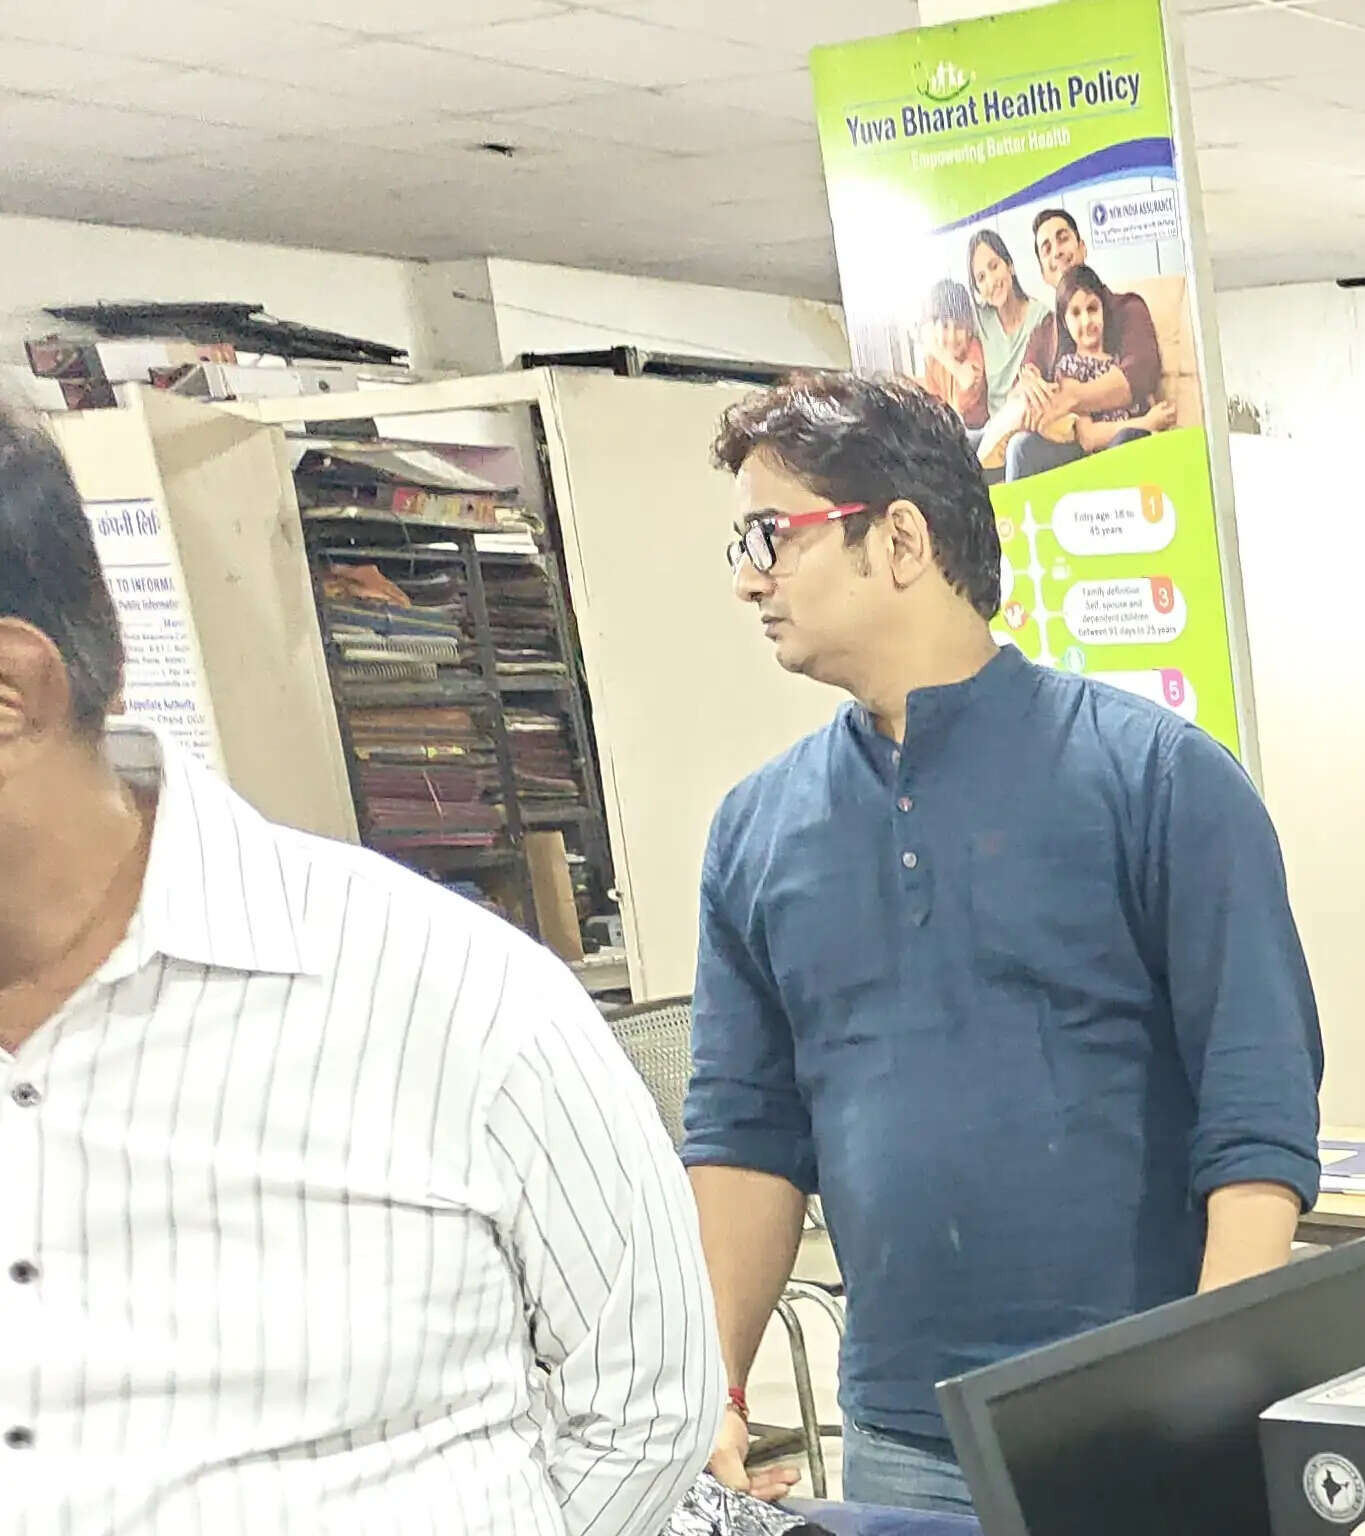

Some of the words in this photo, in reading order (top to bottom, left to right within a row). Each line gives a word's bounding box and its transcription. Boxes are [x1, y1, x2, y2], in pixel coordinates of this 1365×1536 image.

[847, 115, 896, 146] Yuva
[902, 96, 977, 137] Bharat
[985, 81, 1062, 122] Health
[1068, 70, 1140, 108] Policy
[1149, 496, 1155, 515] 1
[1158, 589, 1168, 607] 3
[1169, 680, 1180, 700] 5
